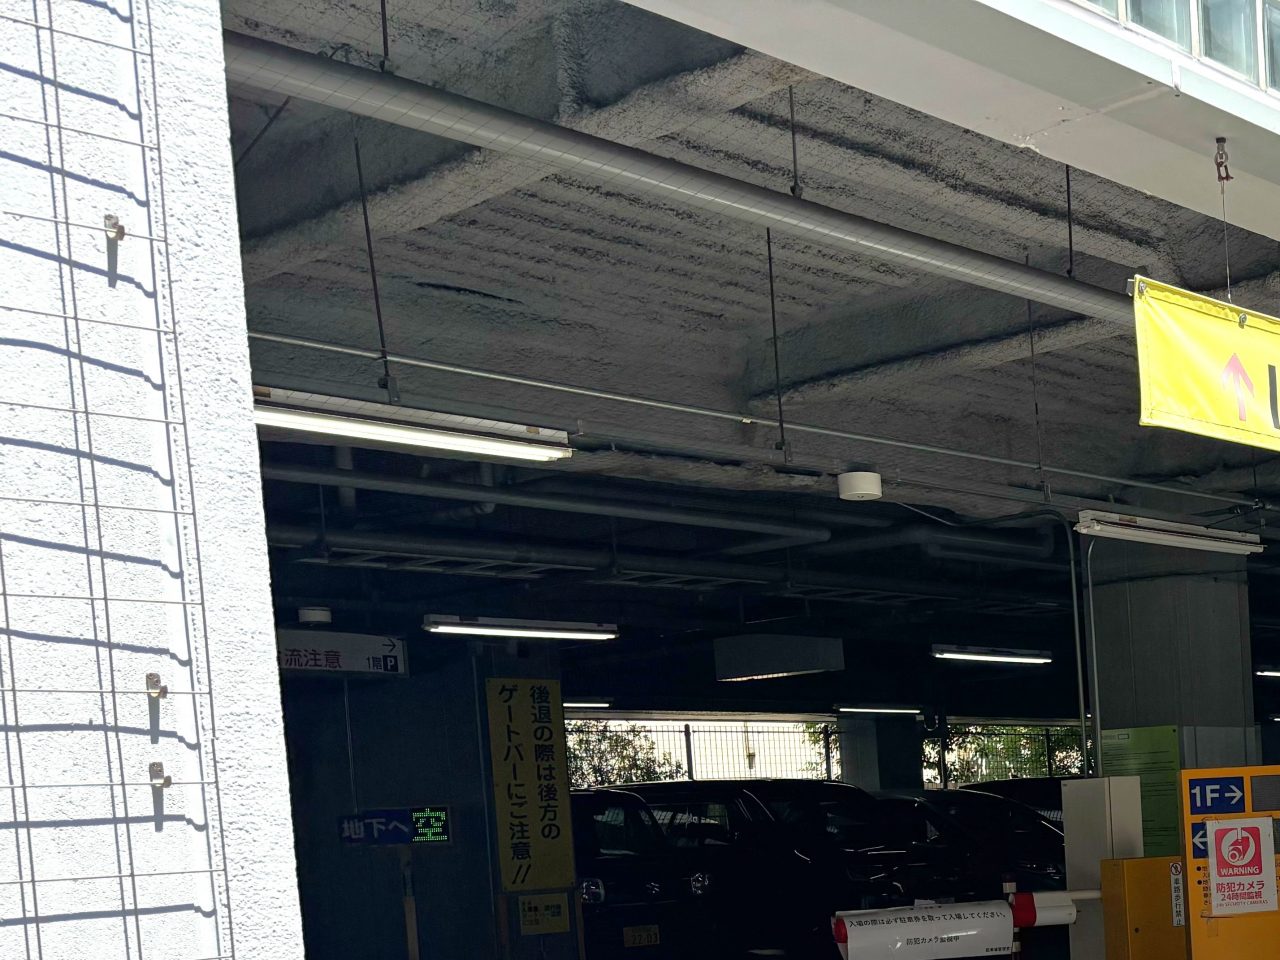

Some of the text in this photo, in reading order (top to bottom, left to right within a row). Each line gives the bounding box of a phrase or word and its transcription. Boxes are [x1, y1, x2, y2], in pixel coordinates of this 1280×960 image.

[278, 648, 342, 669] 流注意
[530, 685, 561, 841] 後退の際は後方の
[1191, 784, 1221, 808] 1F
[342, 817, 409, 840] 地下へ
[412, 807, 449, 842] 空
[1220, 865, 1260, 876] WARNING
[1216, 880, 1265, 894] 防犯カメラ
[1221, 890, 1263, 902] 24時間監視
